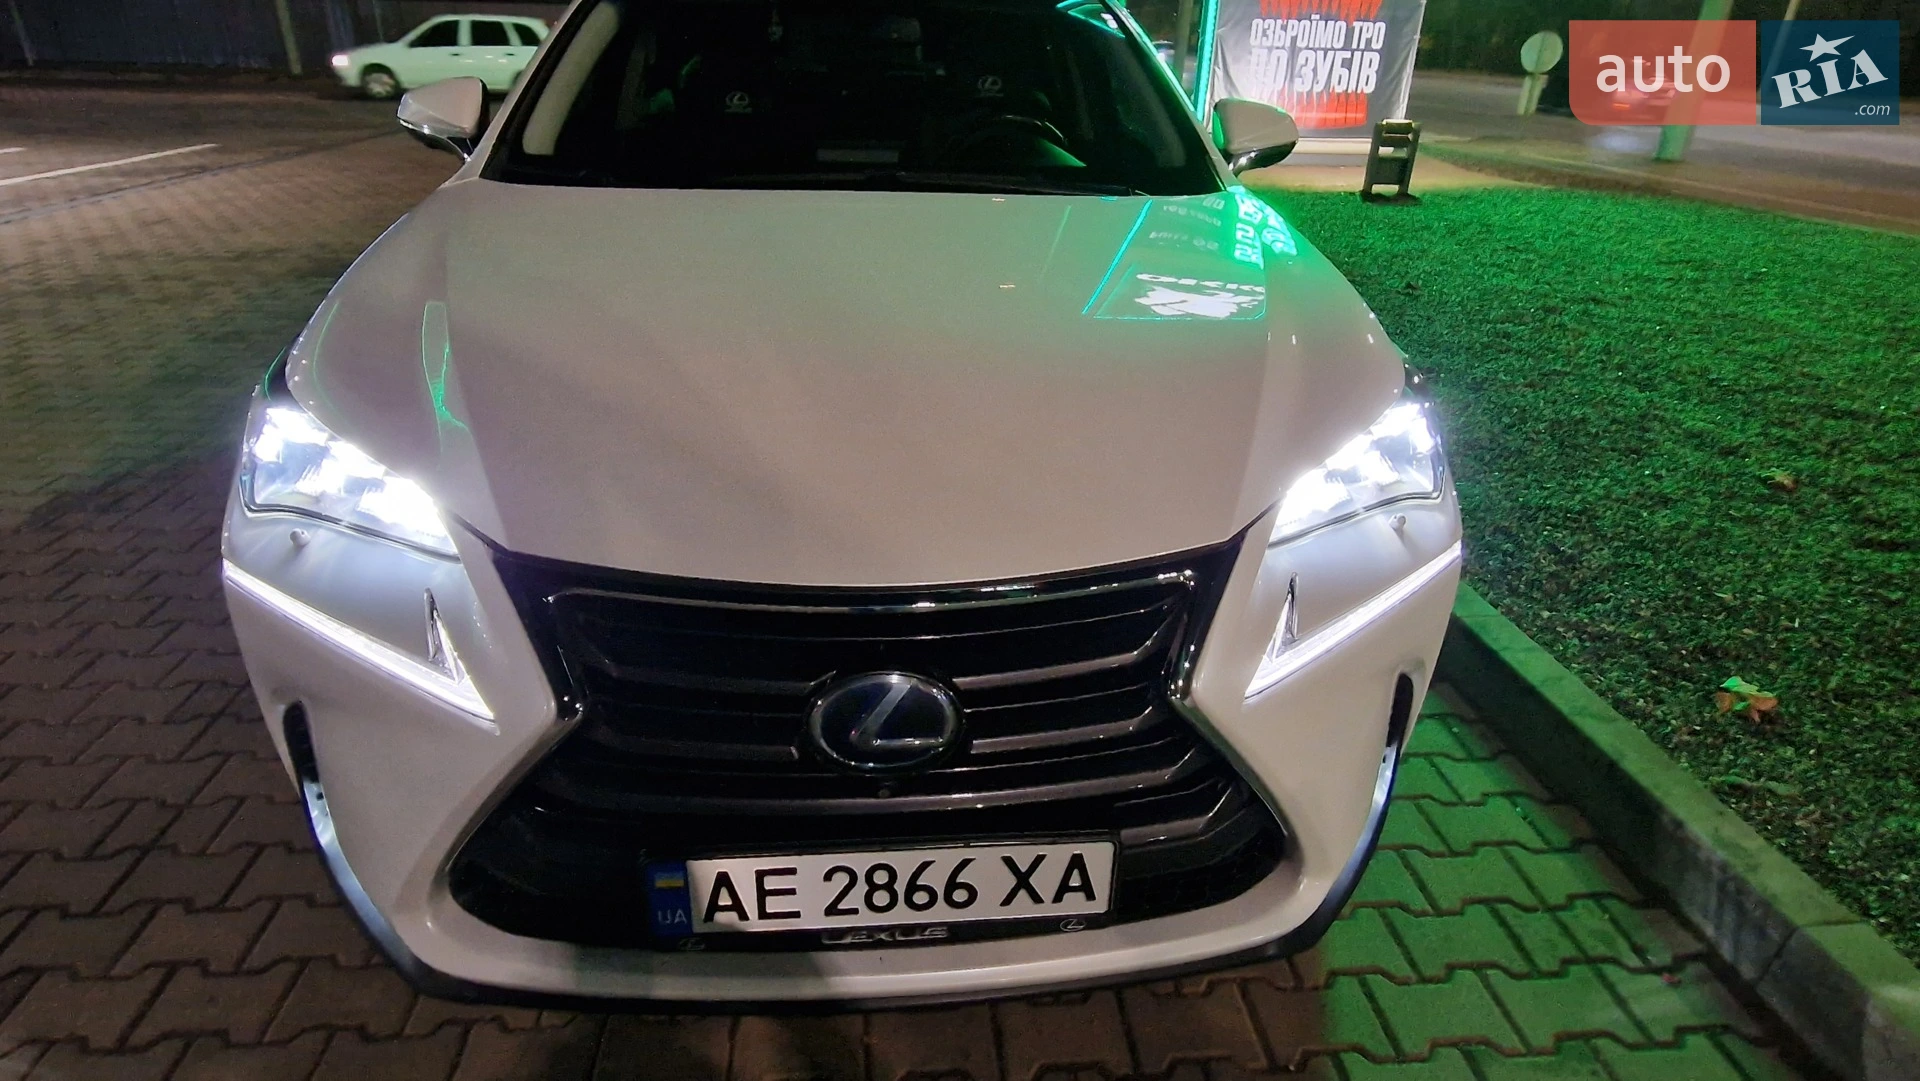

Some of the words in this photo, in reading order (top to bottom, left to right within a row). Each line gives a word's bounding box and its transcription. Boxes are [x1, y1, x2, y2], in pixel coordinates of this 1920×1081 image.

[1250, 14, 1347, 49] ОЗБРОЇМО
[1351, 21, 1386, 49] ТРО
[1294, 49, 1381, 94] ЗУБІВ
[822, 857, 979, 916] 2866
[658, 908, 687, 924] UA
[820, 926, 951, 945] LEXUS
